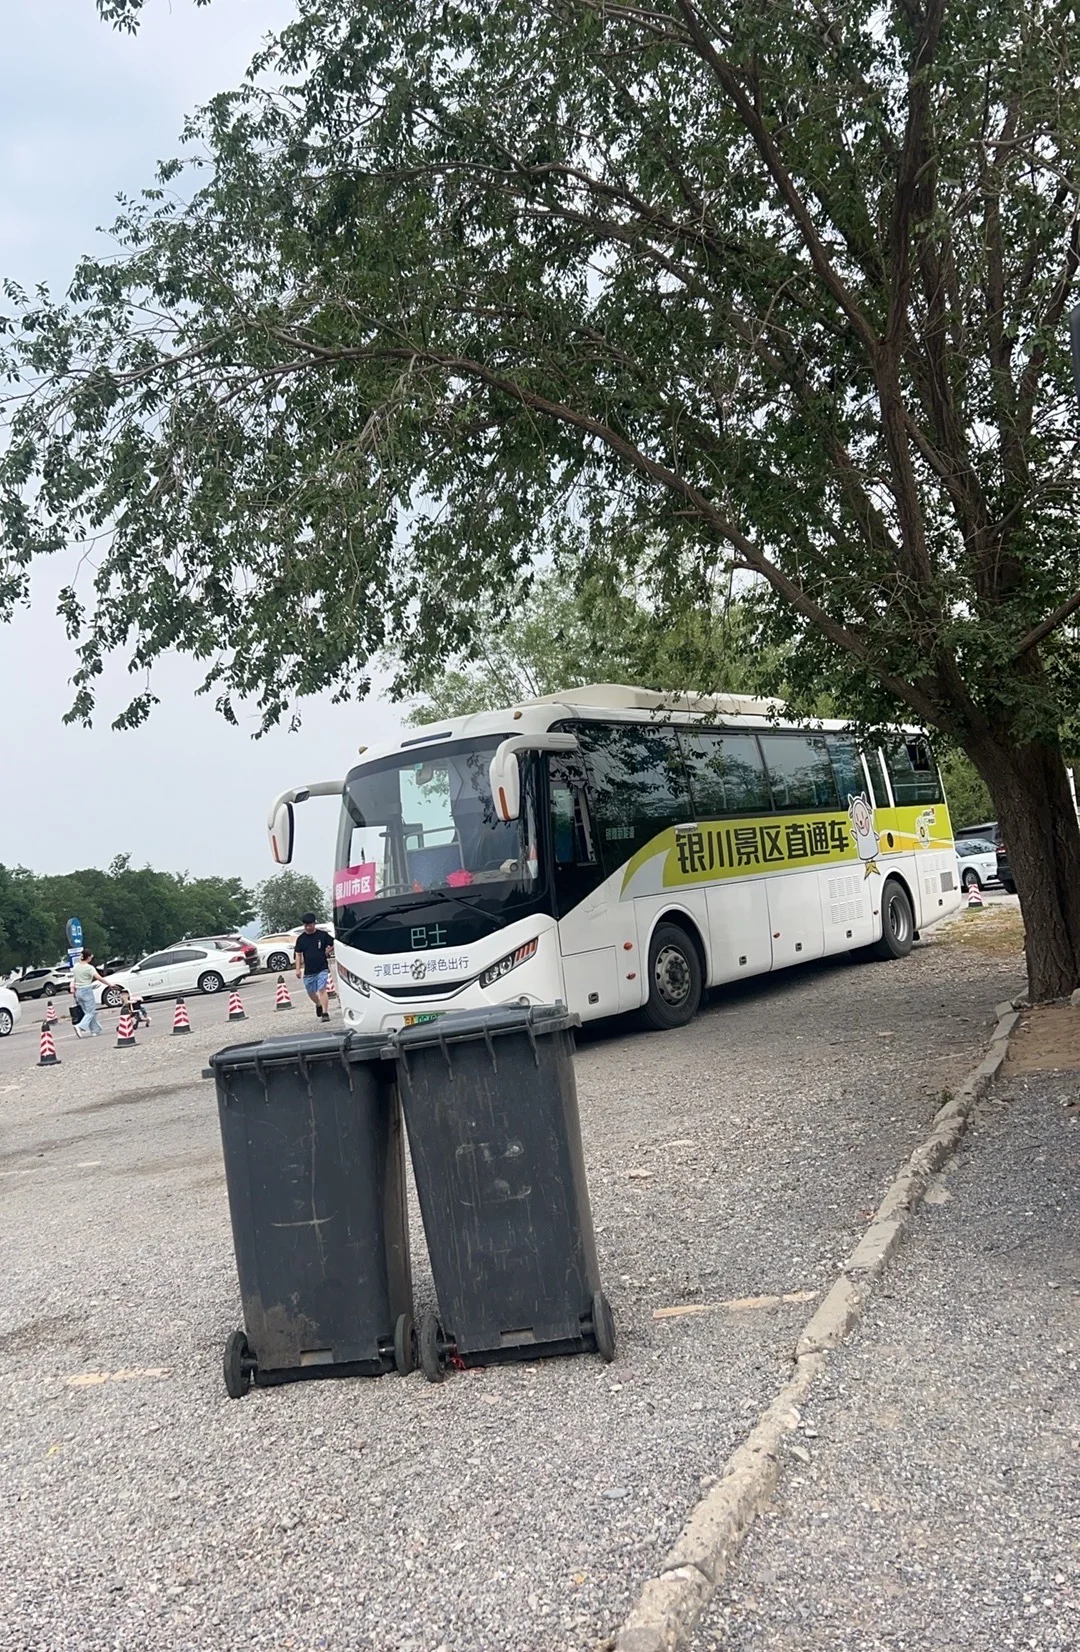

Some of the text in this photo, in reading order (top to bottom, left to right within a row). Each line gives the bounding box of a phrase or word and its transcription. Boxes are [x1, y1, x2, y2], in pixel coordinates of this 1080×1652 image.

[676, 820, 850, 874] 银川景区直通车
[410, 923, 447, 949] 巴士
[374, 956, 470, 977] 宁夏巴士 绿色出行
